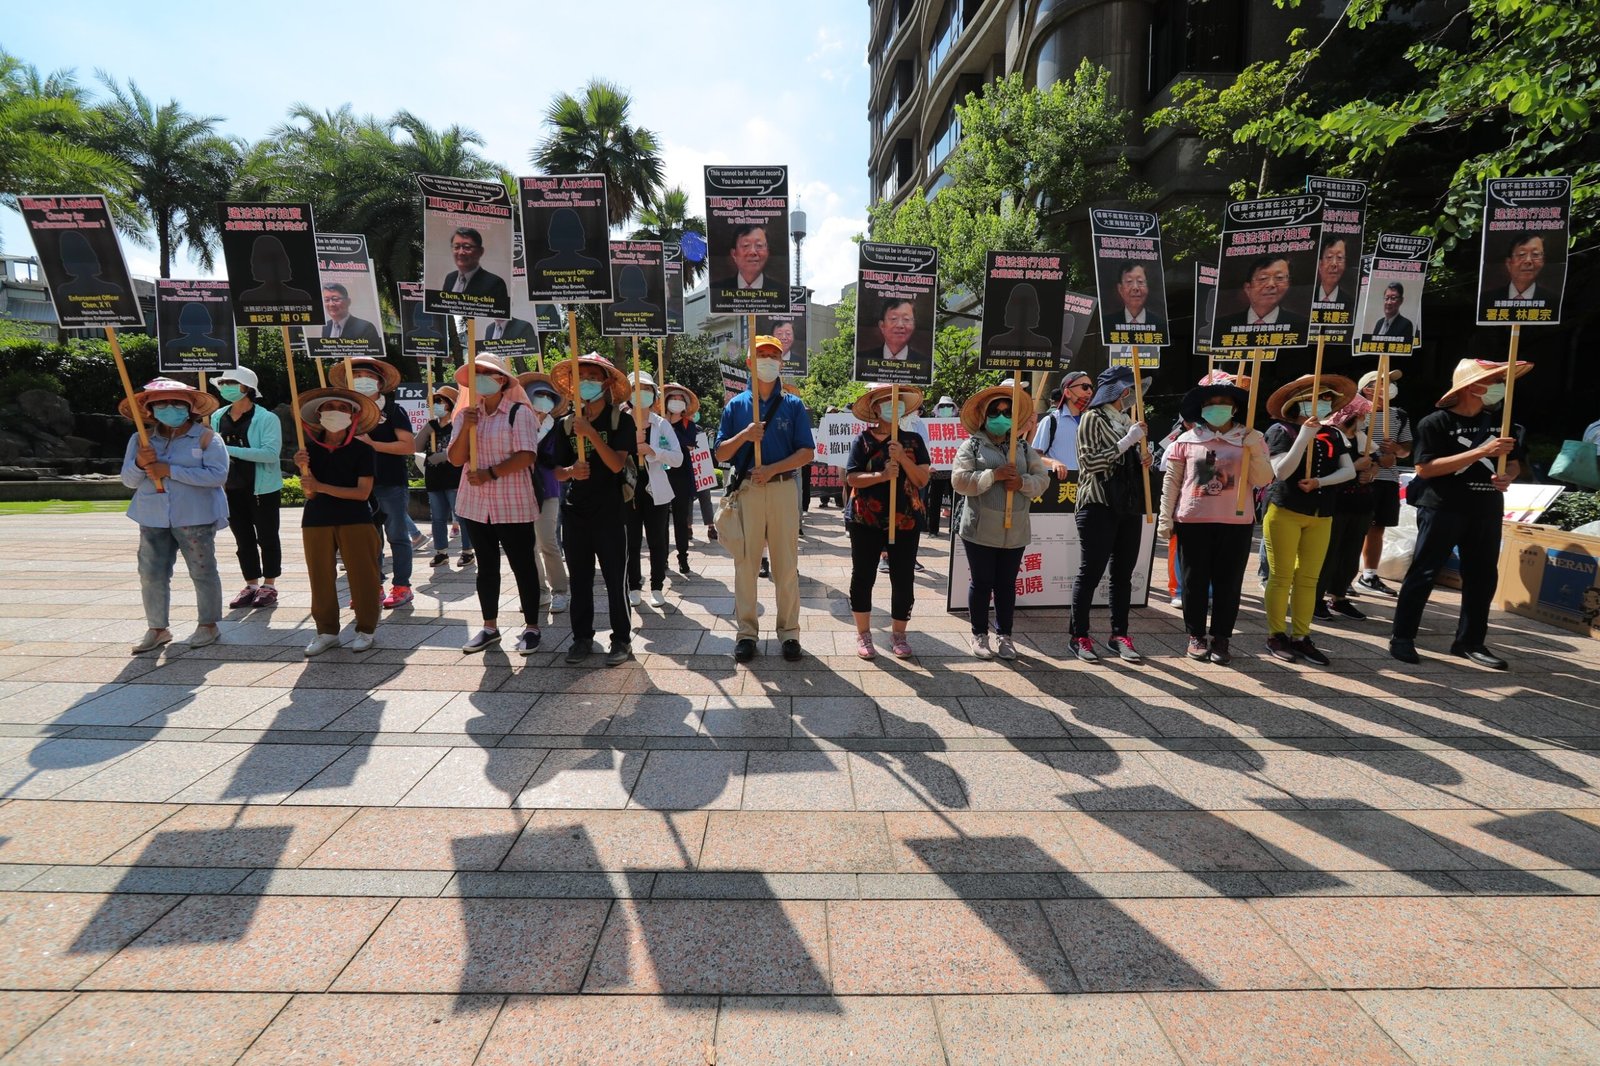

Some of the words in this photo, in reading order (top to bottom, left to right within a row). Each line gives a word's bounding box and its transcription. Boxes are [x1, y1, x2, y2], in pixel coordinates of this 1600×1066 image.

[523, 178, 559, 192] Illegal
[560, 177, 603, 189] Auction
[543, 191, 570, 201] Greedy
[570, 191, 583, 200] for
[20, 197, 58, 212] Illegal
[60, 197, 103, 209] Auction
[428, 197, 464, 212] Illegal
[466, 202, 510, 217] Auction
[709, 197, 743, 210] Illegal
[744, 197, 786, 208] Auction
[227, 206, 303, 220] 違法強行拍賣
[1493, 206, 1562, 220] 違法強行拍賣
[1231, 226, 1312, 246] 違法強行拍賣
[628, 241, 662, 251] Auction
[865, 245, 875, 253] This
[901, 247, 917, 256] official
[896, 254, 908, 262] what
[995, 255, 1060, 270] 違法強行拍賣
[328, 260, 367, 270] Auction
[554, 276, 568, 284] Lee,
[862, 269, 895, 284] Illegal
[894, 271, 934, 286] Auction
[159, 280, 190, 290] Illegal
[191, 280, 230, 289] Auction
[439, 291, 460, 300] Chen,
[462, 293, 495, 303] Ying-chin
[721, 289, 735, 298] Lin,
[736, 289, 778, 299] Ching-Tsung
[81, 301, 99, 309] Chen,
[1494, 300, 1546, 308] 法務部行政執行署
[1322, 310, 1350, 324] 林慶宗
[1486, 309, 1510, 321] 署長
[1515, 309, 1552, 321] 林慶宗
[1230, 323, 1291, 333] 法務部行政執行署
[1109, 331, 1130, 344] 署長
[1133, 331, 1164, 344] 林慶宗
[1221, 334, 1249, 347] 署長
[1254, 332, 1300, 345] 林慶宗
[867, 359, 881, 367] Lin,
[880, 360, 921, 370] Ching-Tsung
[986, 358, 1020, 367] 行政執行官
[397, 387, 423, 398] Tax
[1546, 556, 1594, 575] HERAN
